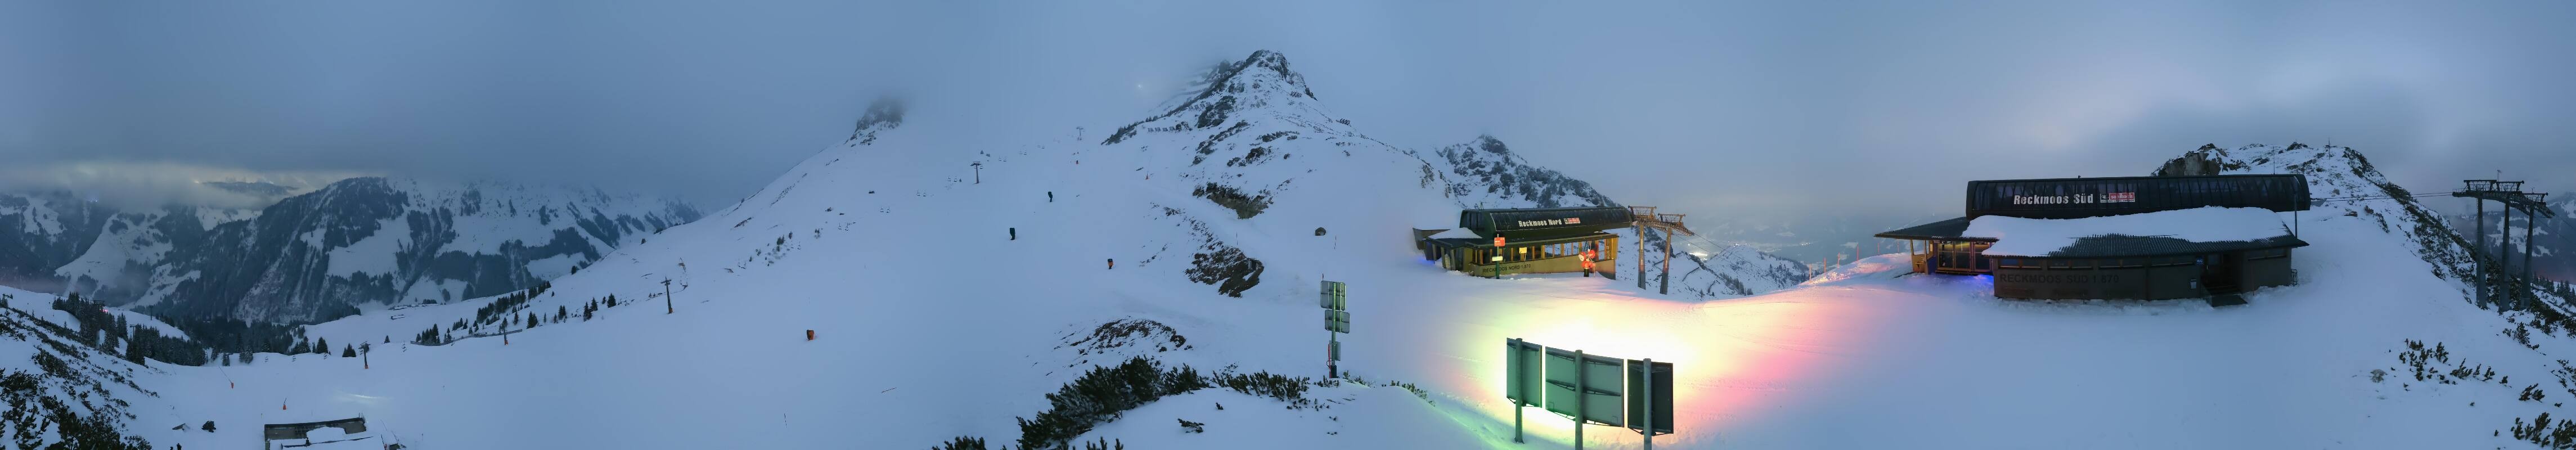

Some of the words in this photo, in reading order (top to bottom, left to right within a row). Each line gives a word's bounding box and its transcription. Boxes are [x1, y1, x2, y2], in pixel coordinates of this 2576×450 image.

[2013, 194, 2069, 205] Reckmoos
[2073, 193, 2093, 204] Süd
[1999, 274, 2061, 284] RECKMOOS
